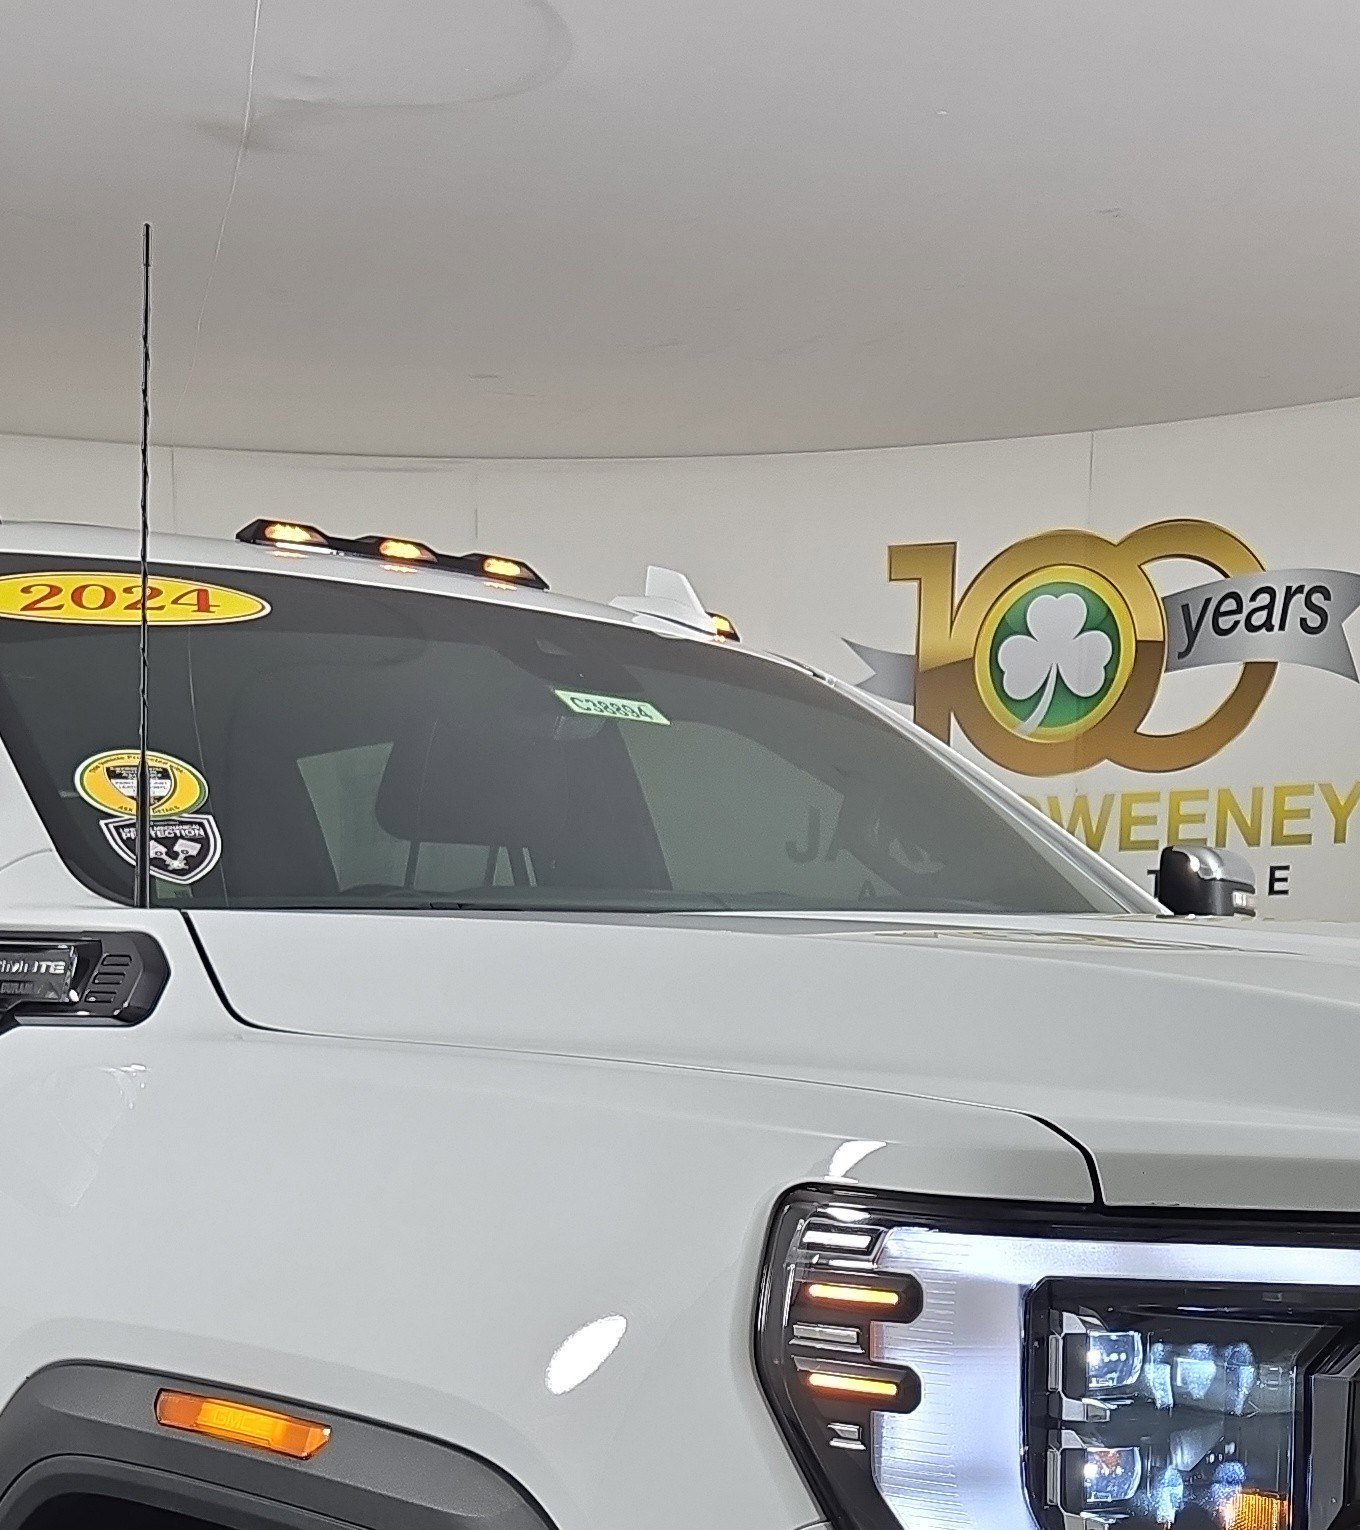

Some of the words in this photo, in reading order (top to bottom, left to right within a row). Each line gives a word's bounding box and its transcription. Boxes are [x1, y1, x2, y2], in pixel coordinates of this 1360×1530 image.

[19, 583, 221, 614] 2024
[1177, 583, 1332, 660] years
[888, 518, 1280, 778] 100
